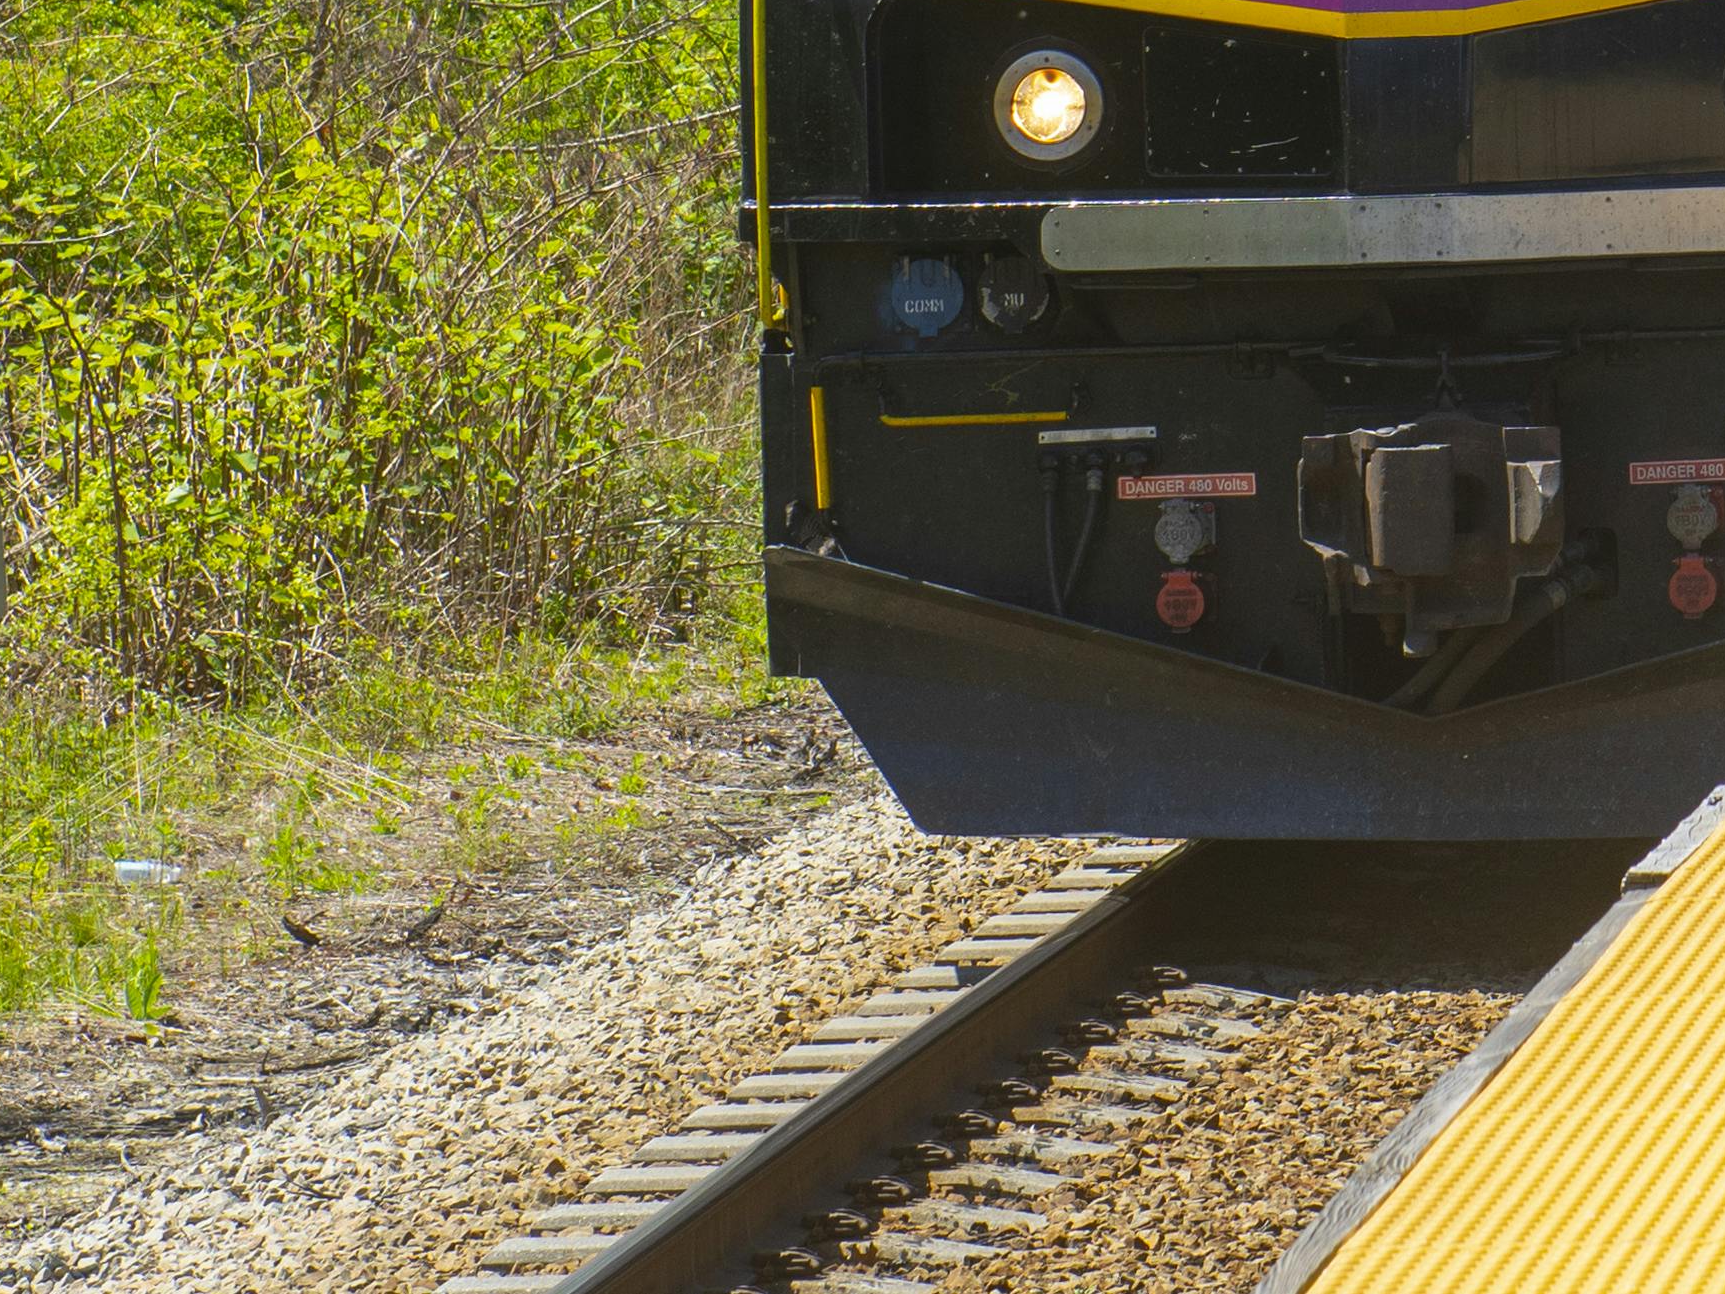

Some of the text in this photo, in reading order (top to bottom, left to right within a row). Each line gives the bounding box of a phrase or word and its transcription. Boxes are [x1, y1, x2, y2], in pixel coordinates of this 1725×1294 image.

[904, 298, 945, 314] COMM
[1003, 293, 1025, 307] MU
[1636, 465, 1696, 480] DANGER
[1700, 464, 1724, 477] 480
[1125, 479, 1249, 494] DANGER 480 Volts
